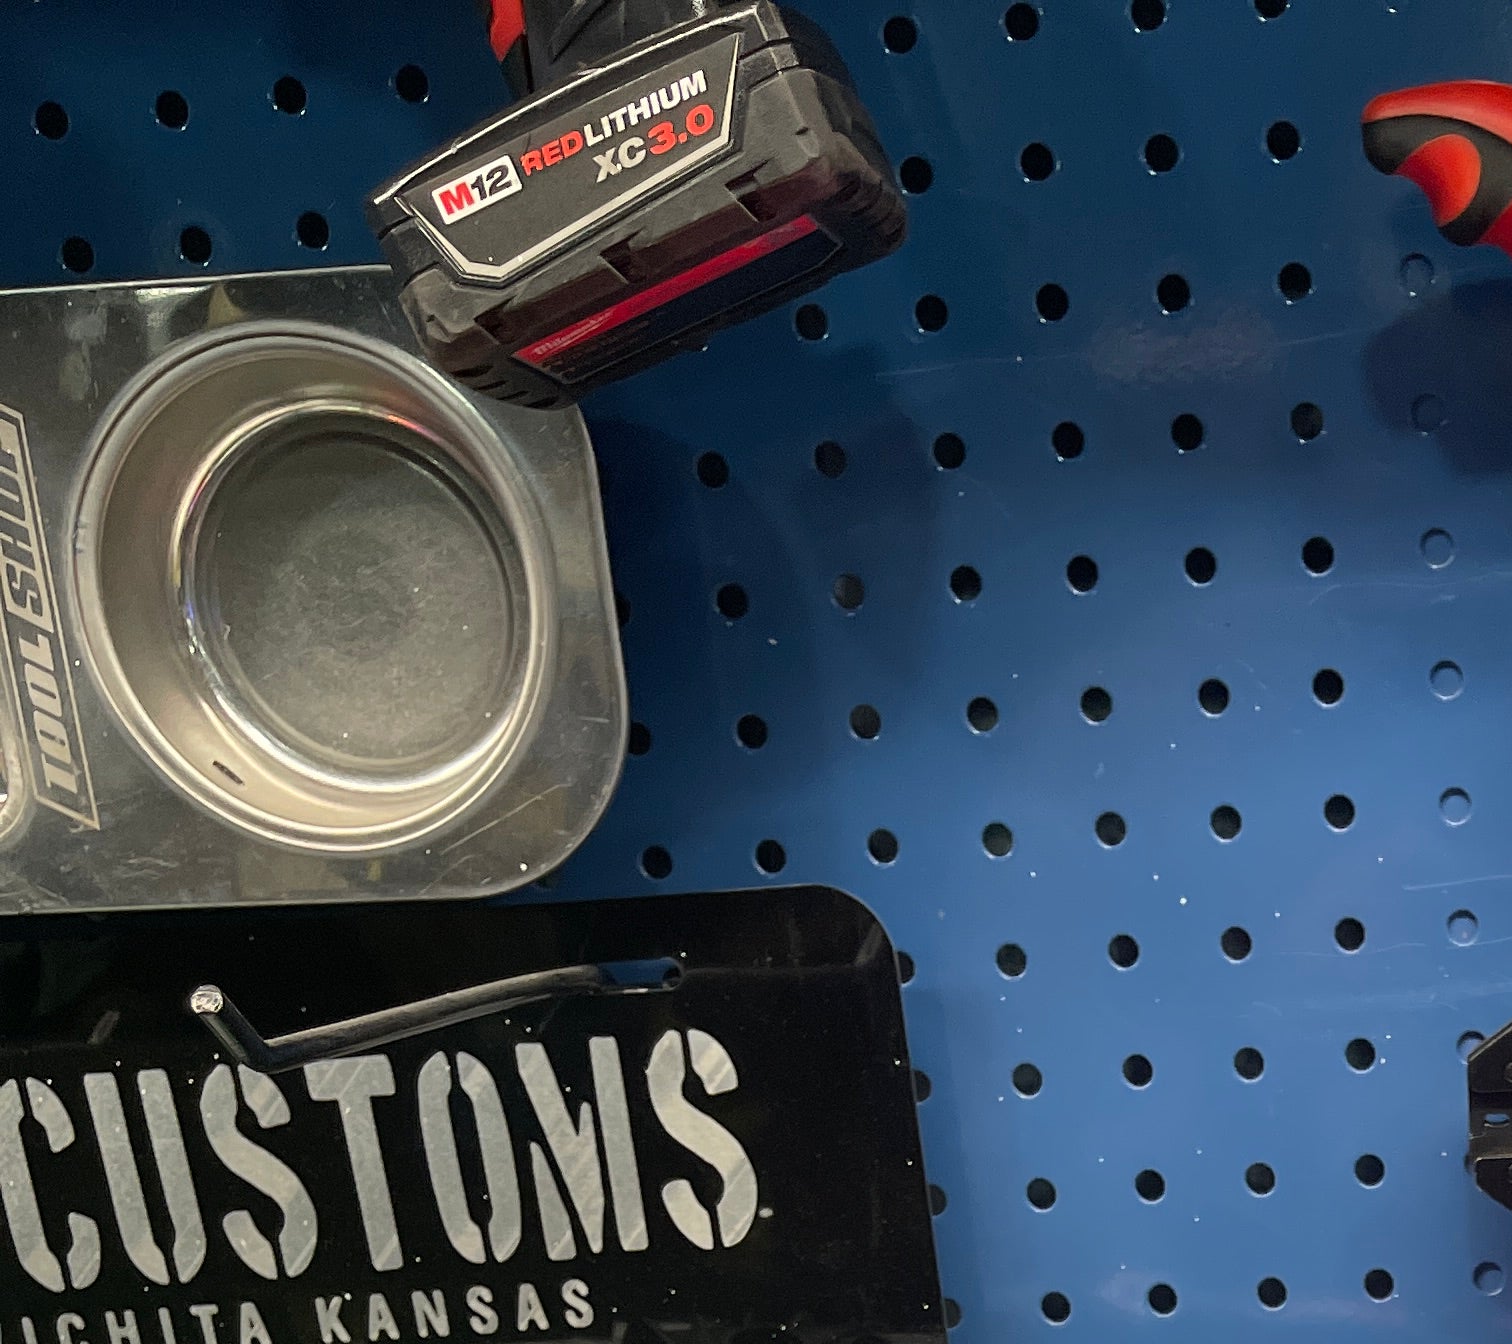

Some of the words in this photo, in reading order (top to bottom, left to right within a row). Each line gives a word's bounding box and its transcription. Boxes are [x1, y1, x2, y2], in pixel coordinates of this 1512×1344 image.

[439, 165, 514, 216] M12
[520, 70, 707, 176] REDLITHIUM
[18, 633, 79, 794] TOOL
[0, 1028, 759, 1293] CUSTOMS
[315, 1278, 594, 1344] KANSAS
